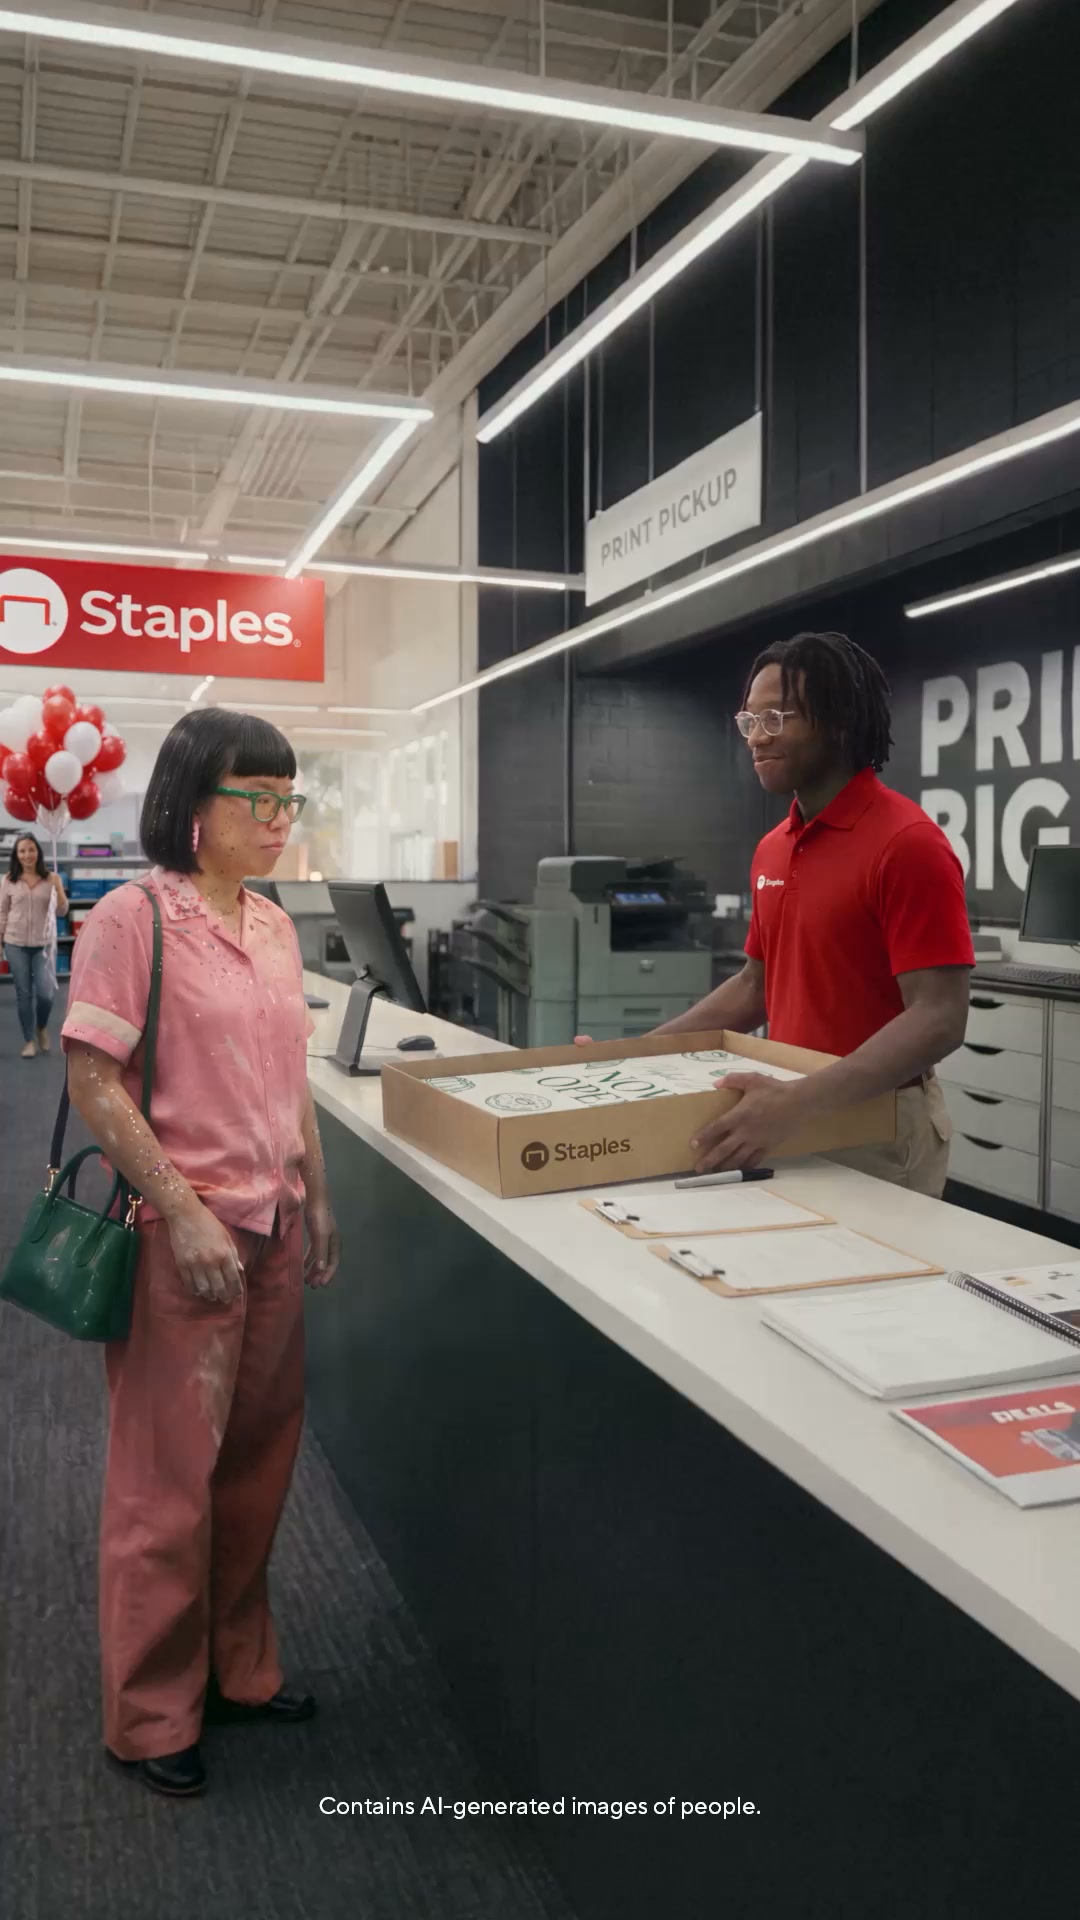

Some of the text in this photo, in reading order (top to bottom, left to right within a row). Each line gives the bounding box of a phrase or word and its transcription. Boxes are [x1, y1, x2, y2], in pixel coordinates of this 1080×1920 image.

[601, 467, 737, 566] PRINT PICKUP
[80, 590, 293, 652] Staples
[554, 1137, 631, 1162] Staples
